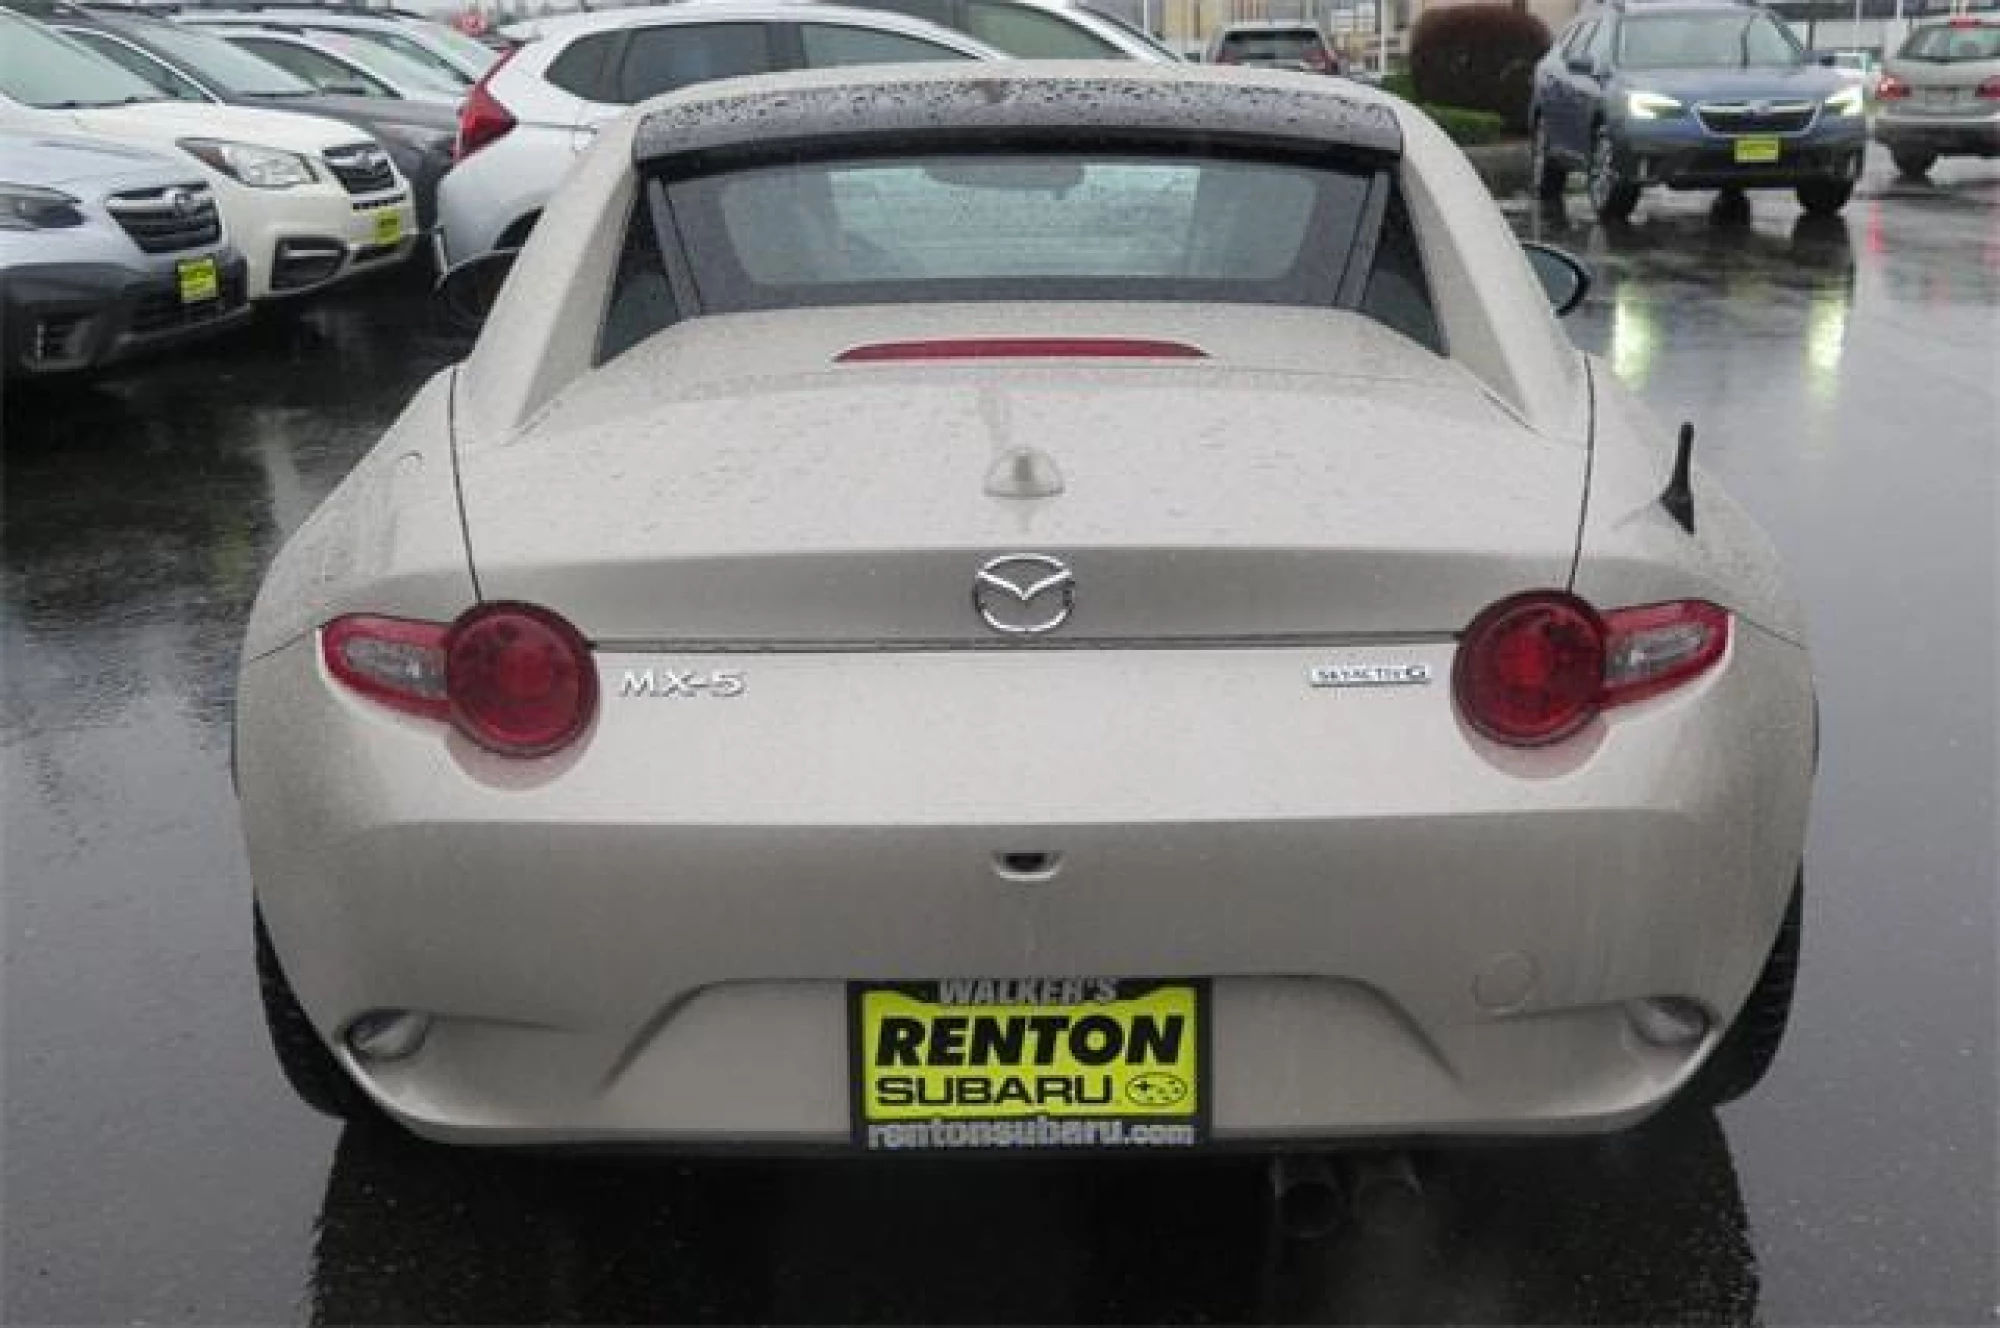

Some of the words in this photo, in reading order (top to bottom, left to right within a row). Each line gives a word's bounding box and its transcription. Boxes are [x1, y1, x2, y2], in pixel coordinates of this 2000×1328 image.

[620, 669, 746, 698] MX-5
[938, 979, 1118, 1004] WALKER'S
[875, 1015, 1185, 1067] RENTON
[876, 1076, 1113, 1106] SUBARU
[868, 1118, 1196, 1149] rentonsubaru.com
